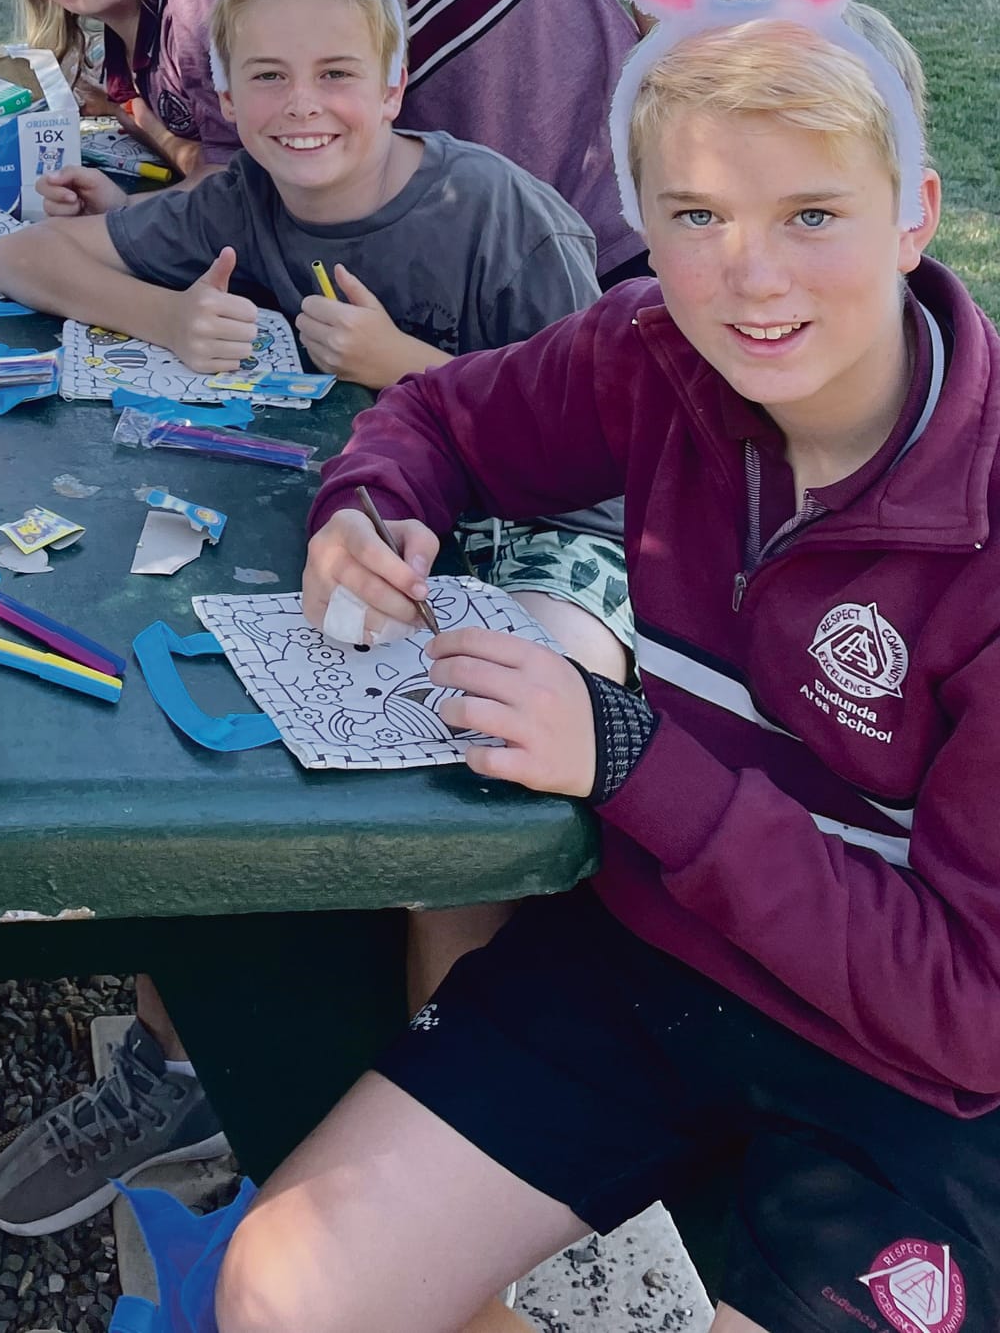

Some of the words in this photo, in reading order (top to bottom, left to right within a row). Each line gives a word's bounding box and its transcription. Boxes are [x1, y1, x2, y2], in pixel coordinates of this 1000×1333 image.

[25, 117, 71, 128] ORIGINAL
[820, 609, 861, 634] RESPECT
[818, 650, 872, 696] EXCELLENCE
[881, 628, 905, 686] COMMUNITY
[800, 684, 830, 714] Area
[836, 710, 893, 744] School
[814, 679, 877, 723] Eudunda
[882, 1243, 929, 1267] RESPECT
[937, 1273, 963, 1333] COMMUNI
